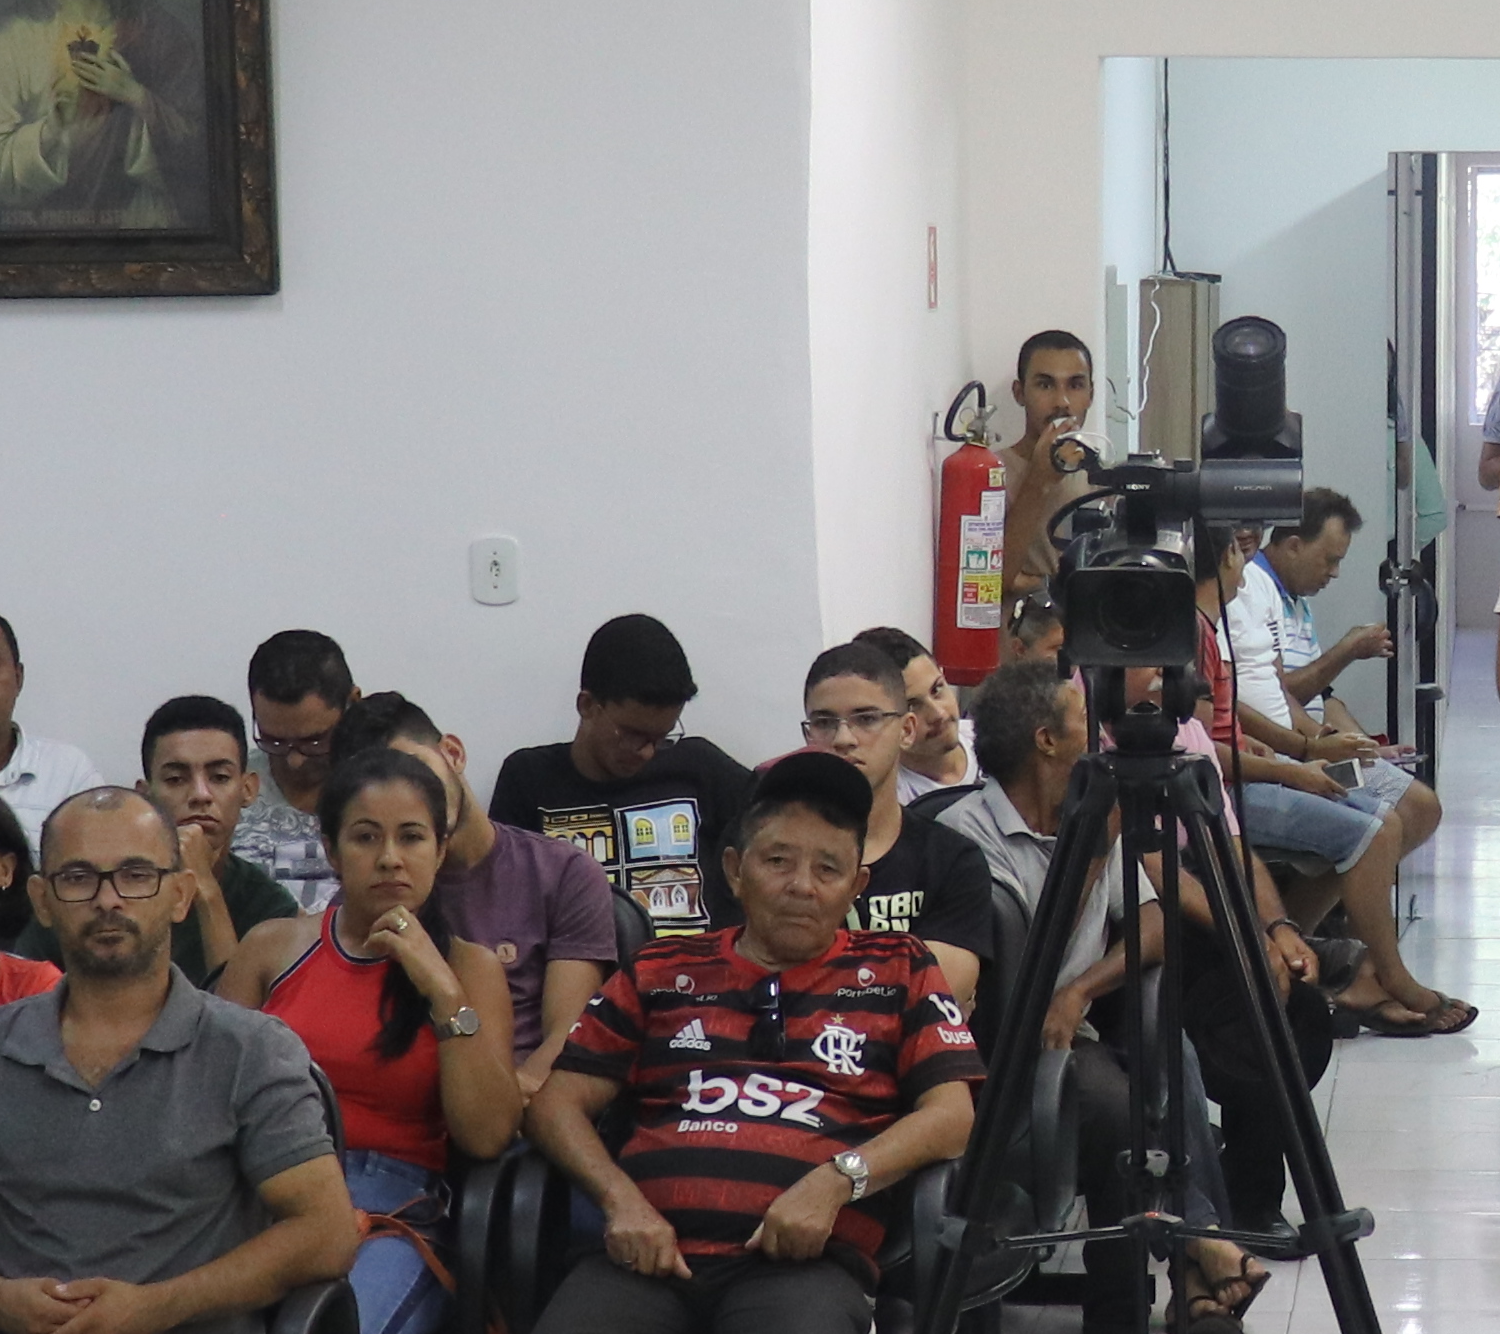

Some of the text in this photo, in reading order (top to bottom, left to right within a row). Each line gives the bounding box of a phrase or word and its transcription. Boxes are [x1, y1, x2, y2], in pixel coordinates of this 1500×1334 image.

[669, 1035, 712, 1051] adidas
[681, 1069, 825, 1129] bs2
[677, 1119, 739, 1134] Banco
